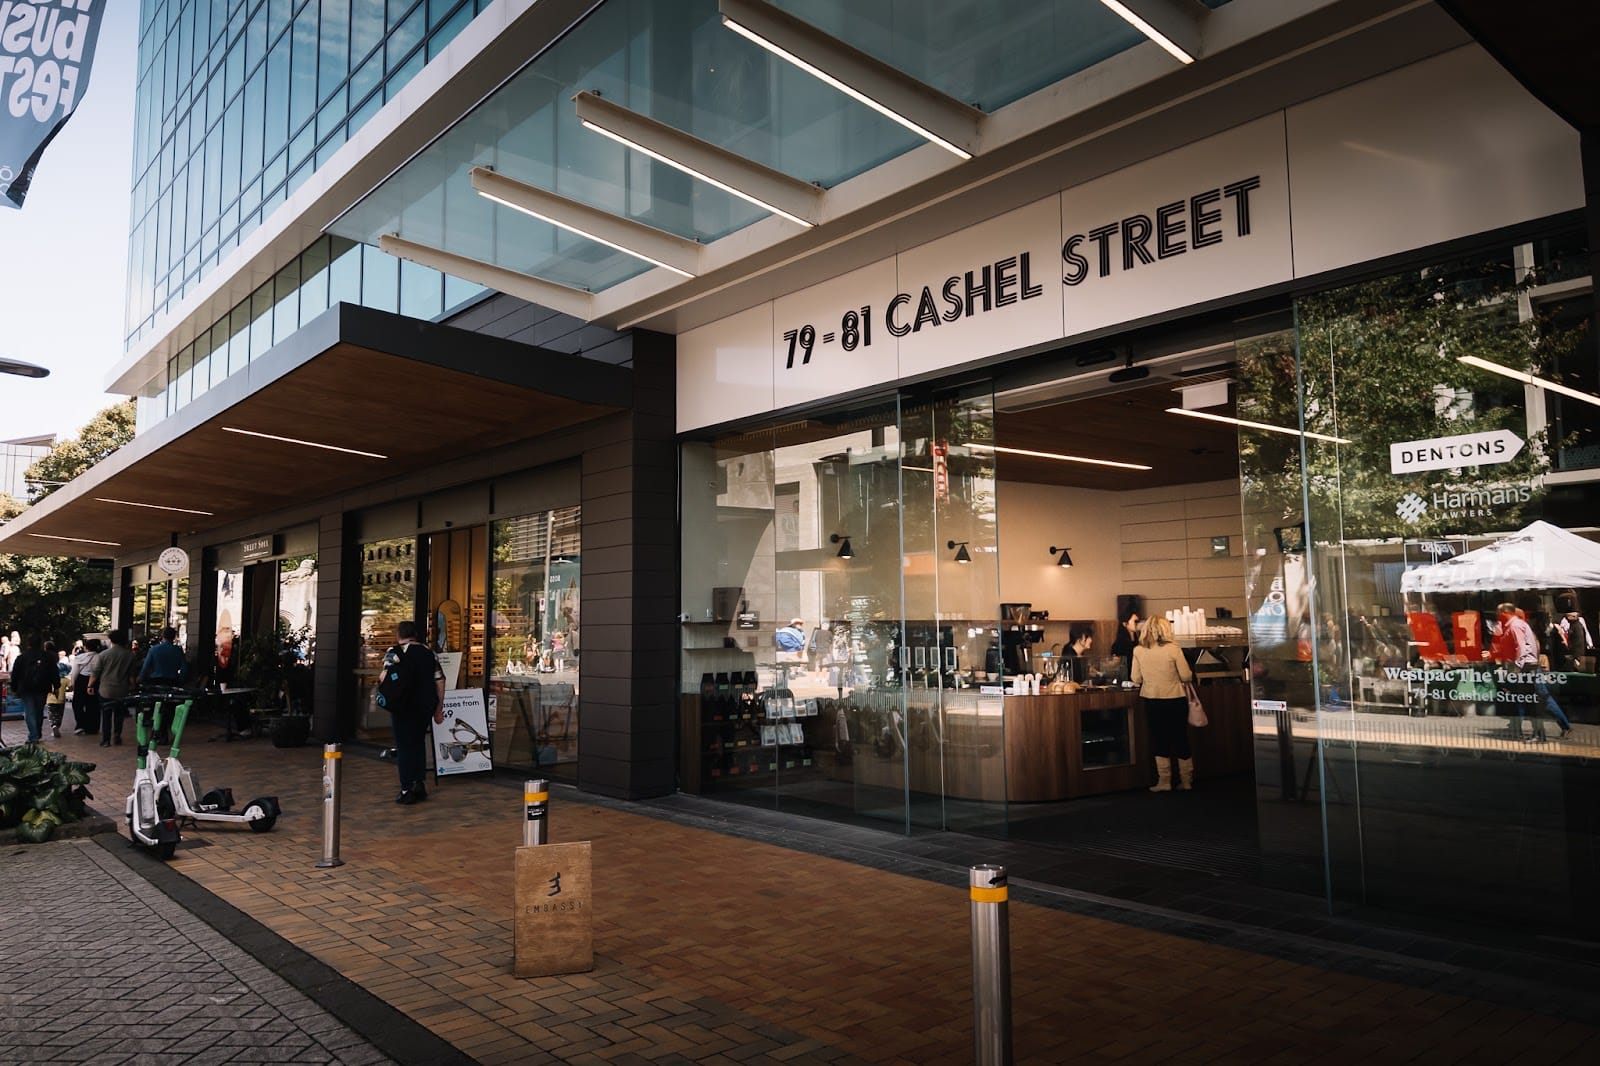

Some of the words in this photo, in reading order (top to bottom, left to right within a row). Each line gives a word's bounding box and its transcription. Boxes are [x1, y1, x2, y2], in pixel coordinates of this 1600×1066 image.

[886, 252, 1043, 338] CASHEL
[1061, 175, 1260, 286] STREET
[1401, 439, 1506, 464] DENTONS
[1432, 485, 1531, 510] Harmans
[1434, 509, 1493, 521] LAWYERS
[1383, 667, 1455, 686] Westpac
[1456, 668, 1493, 683] The
[1494, 669, 1568, 685] Terrace
[1413, 687, 1447, 700] 79-81
[1448, 690, 1494, 703] Cashel
[1496, 691, 1539, 704] Street
